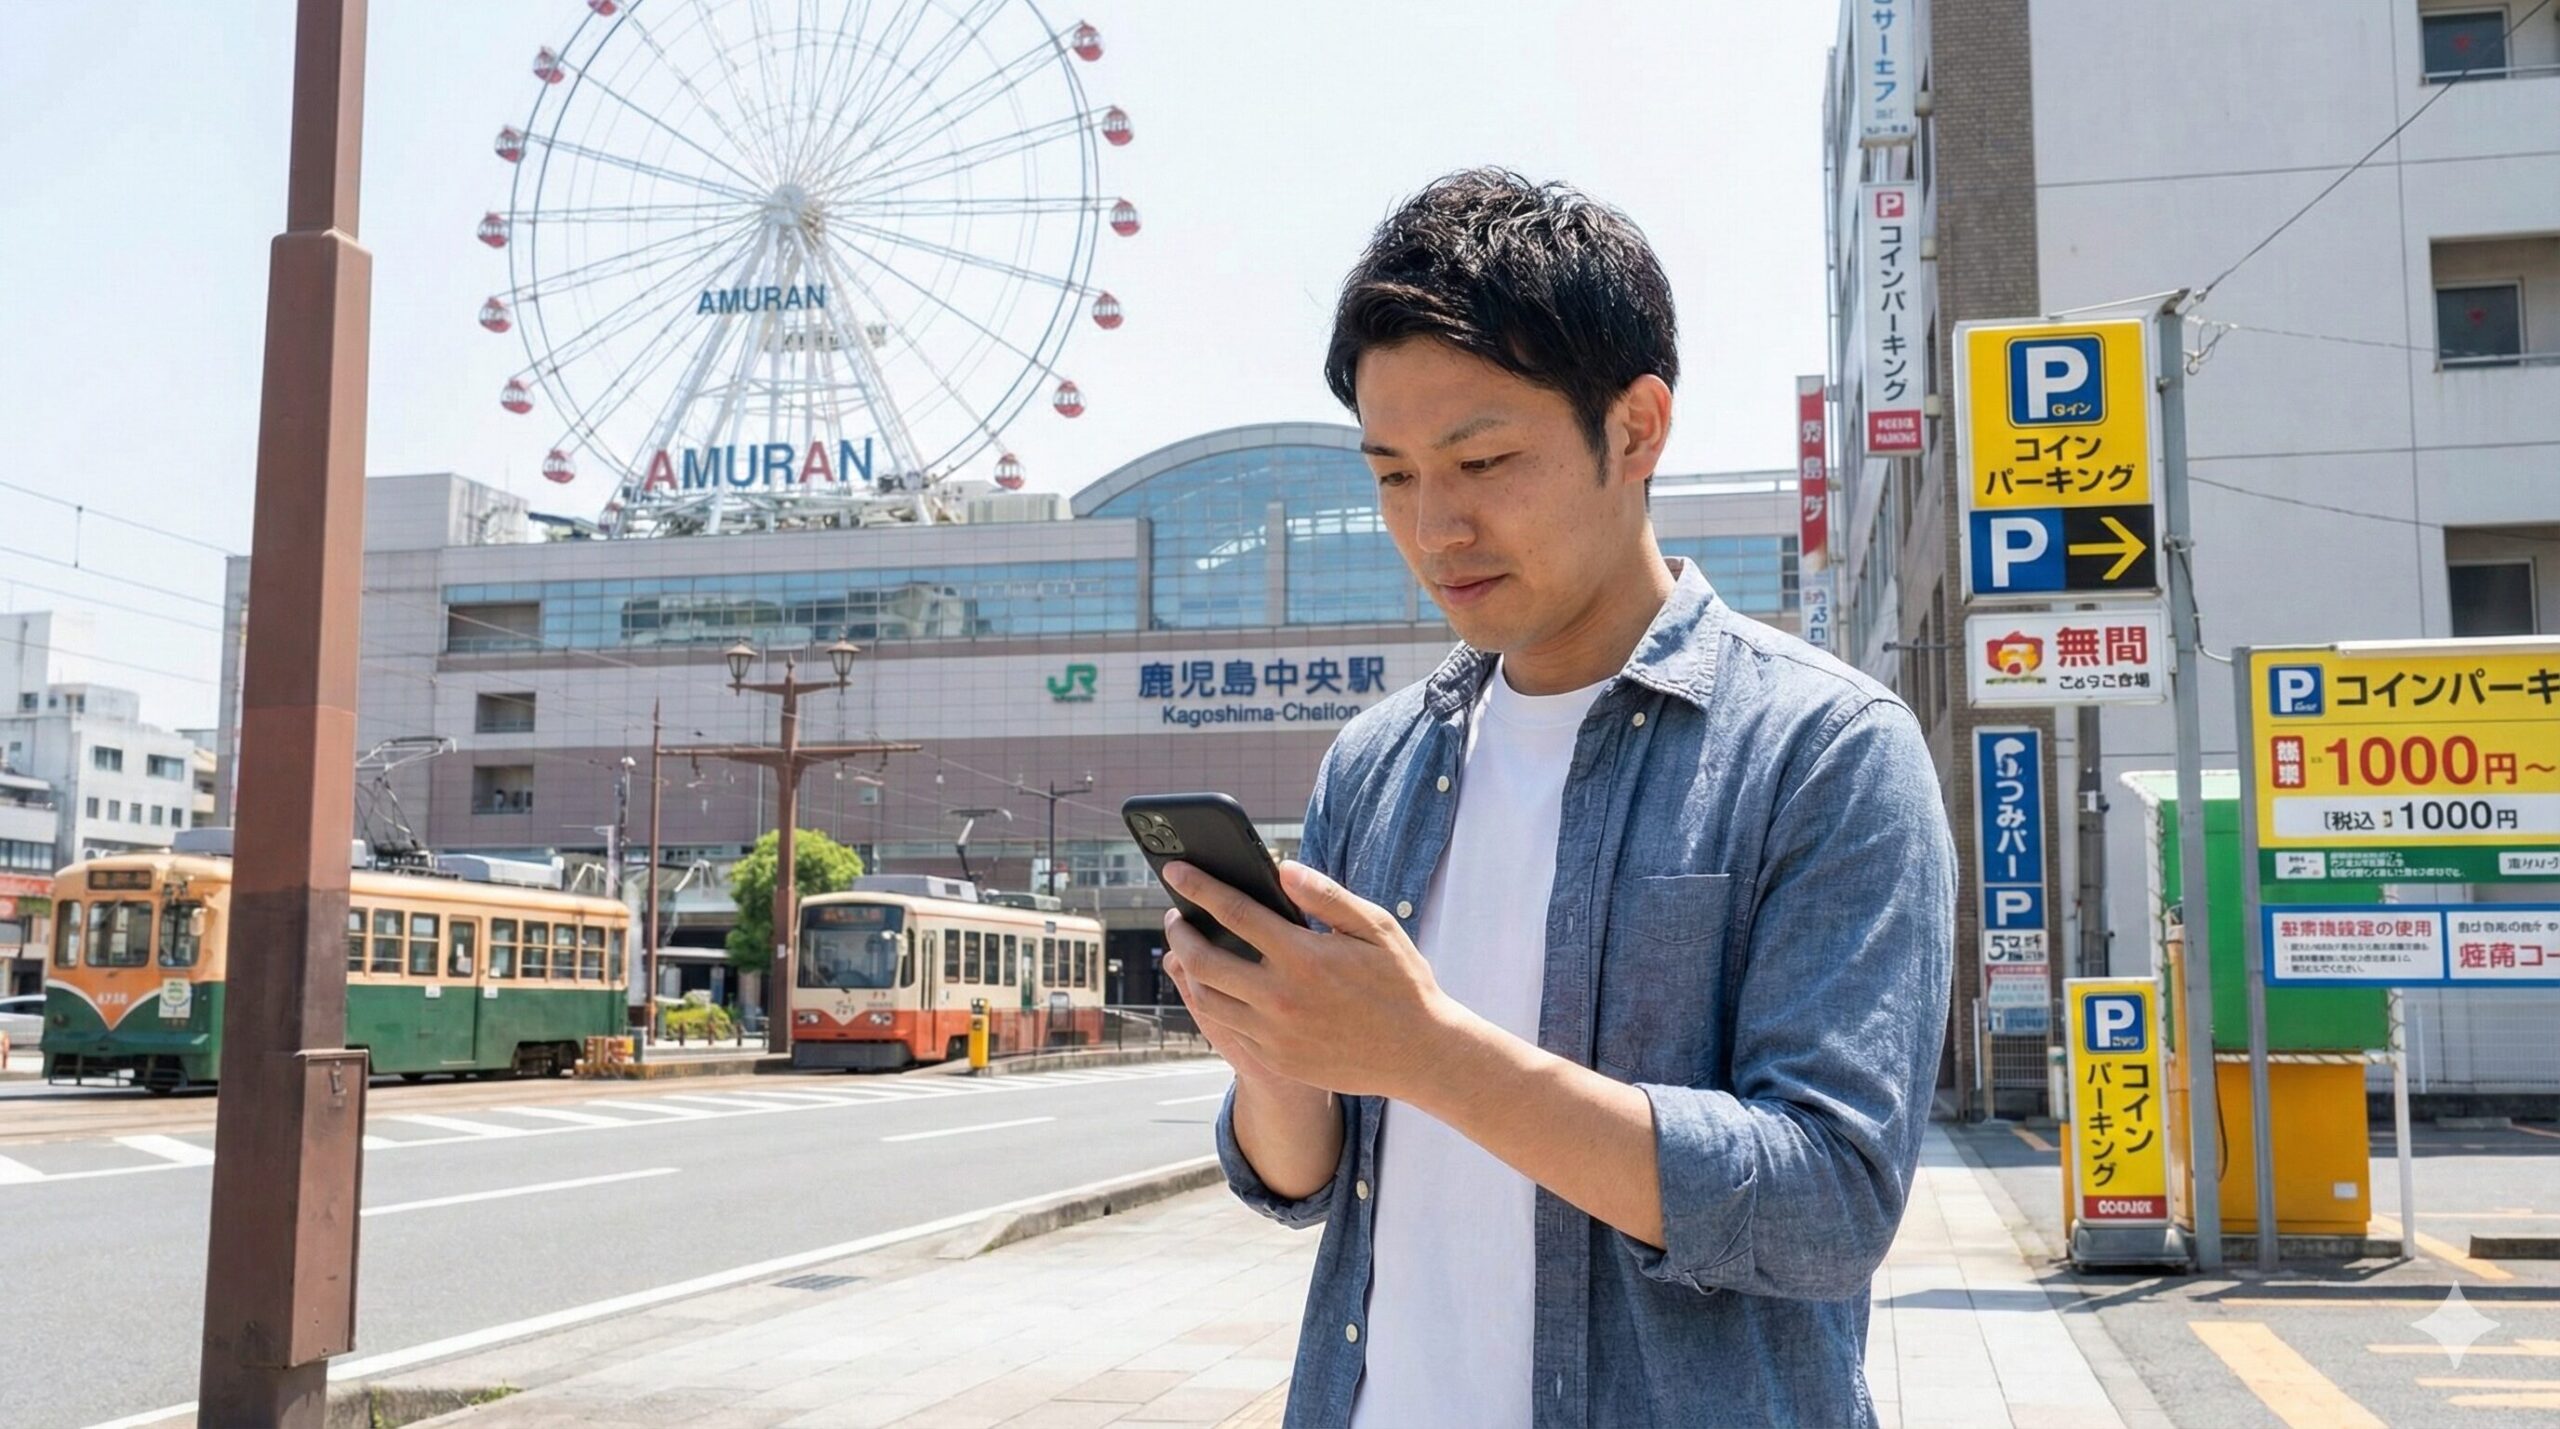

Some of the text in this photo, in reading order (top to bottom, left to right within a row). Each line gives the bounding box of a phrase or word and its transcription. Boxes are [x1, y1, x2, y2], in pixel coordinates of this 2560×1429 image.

[1880, 194, 1901, 216] P
[696, 284, 826, 315] AMURAN
[2025, 346, 2089, 419] P
[644, 437, 873, 491] AMURAN
[2015, 435, 2102, 461] コイン
[1985, 464, 2135, 495] パーキング
[1990, 517, 2049, 587] P
[2056, 626, 2147, 668] 無間
[1047, 664, 1098, 696] JR
[1138, 656, 1386, 698] 鹿児島中央駅
[2278, 670, 2315, 712] P
[2337, 668, 2560, 707] コインパーキ
[1996, 891, 2032, 926] P
[2095, 1000, 2135, 1047] P
[2087, 1062, 2117, 1187] パーキング
[2122, 1064, 2154, 1153] コイン
